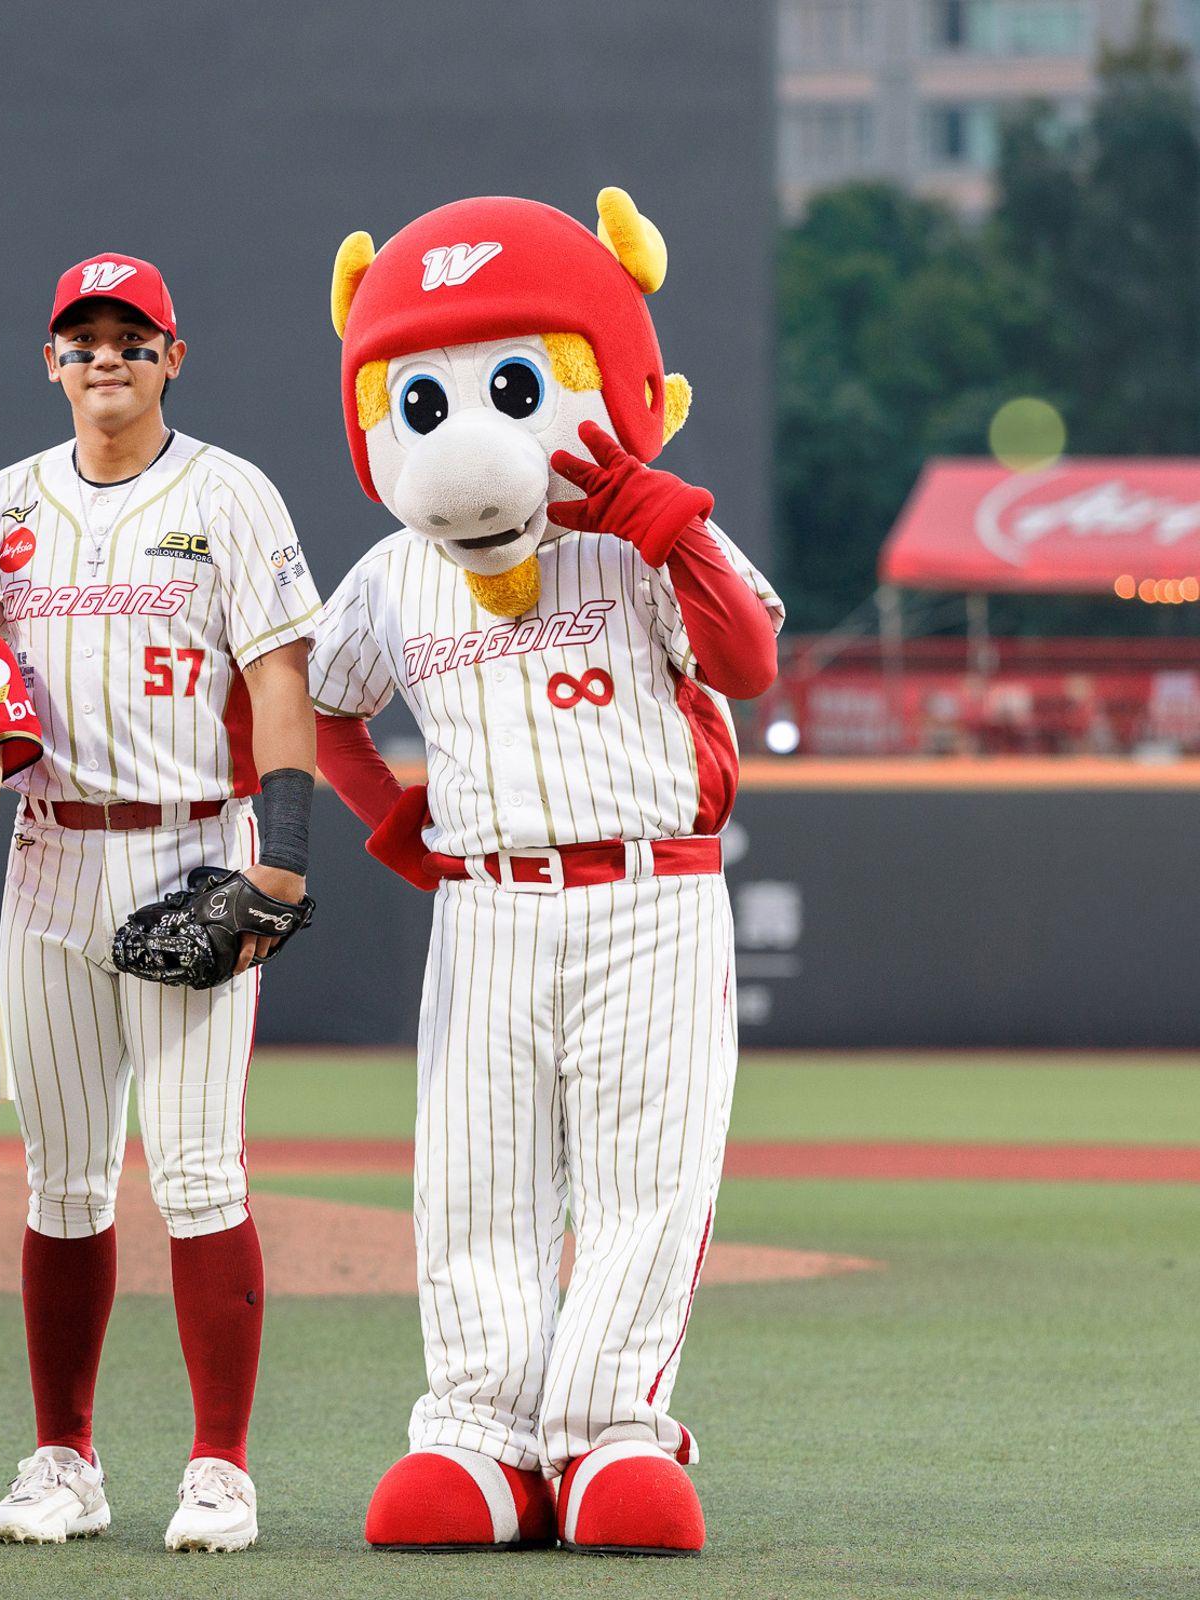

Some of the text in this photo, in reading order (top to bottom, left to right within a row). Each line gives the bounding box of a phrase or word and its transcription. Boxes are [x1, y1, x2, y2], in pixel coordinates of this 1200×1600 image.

[80, 262, 137, 294] W
[421, 242, 503, 292] W
[145, 548, 184, 559] COILOVER
[2, 579, 198, 623] DRAGONS
[403, 600, 616, 688] DRAGONS
[144, 646, 205, 696] 57
